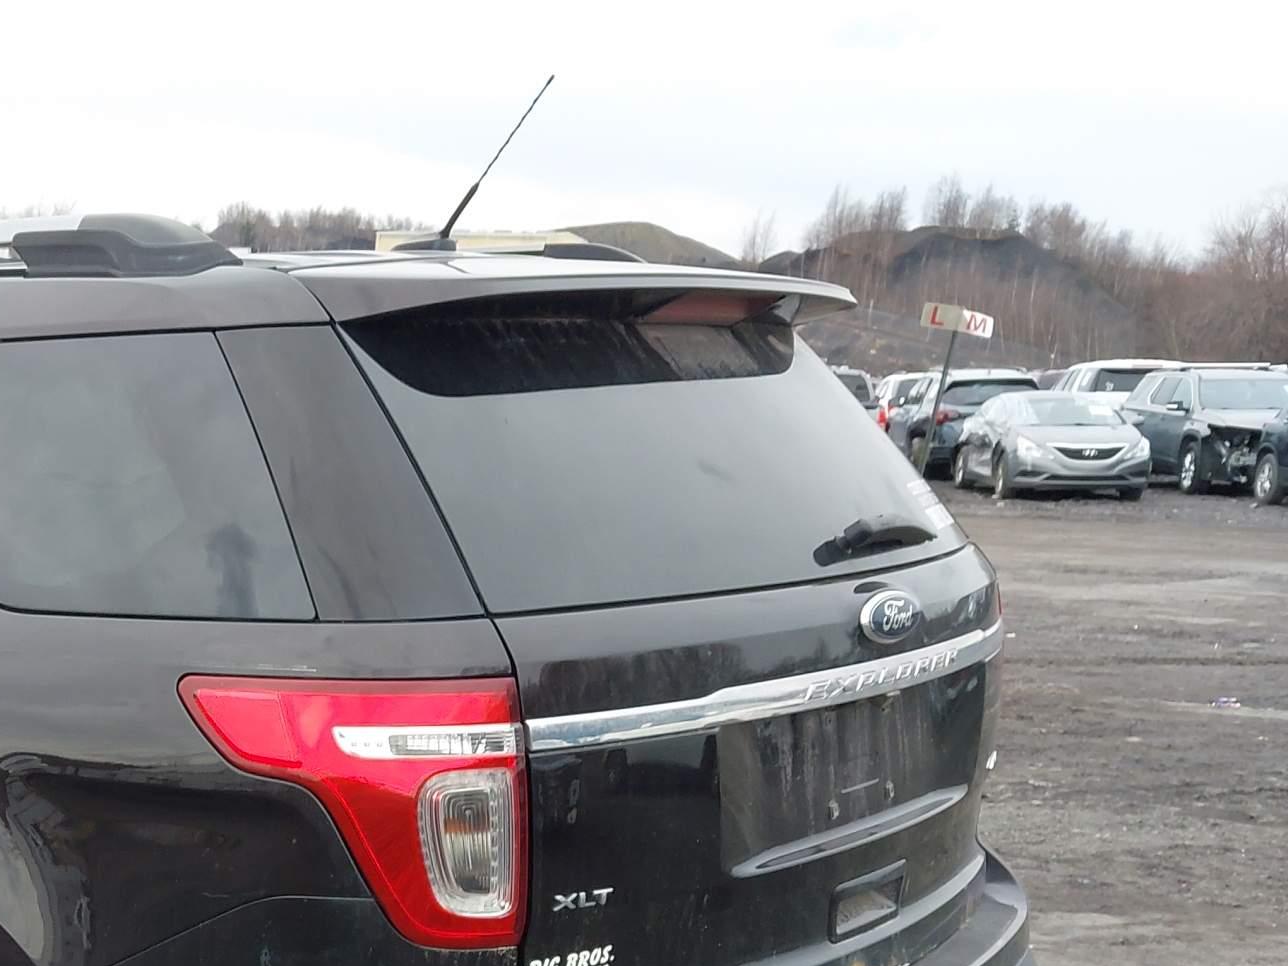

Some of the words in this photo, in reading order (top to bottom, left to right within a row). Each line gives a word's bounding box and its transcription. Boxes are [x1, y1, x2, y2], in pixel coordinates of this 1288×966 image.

[930, 305, 944, 326] L
[966, 314, 987, 334] M
[882, 599, 913, 632] Ford
[803, 648, 959, 702] EXPLORER
[553, 887, 614, 912] XLT
